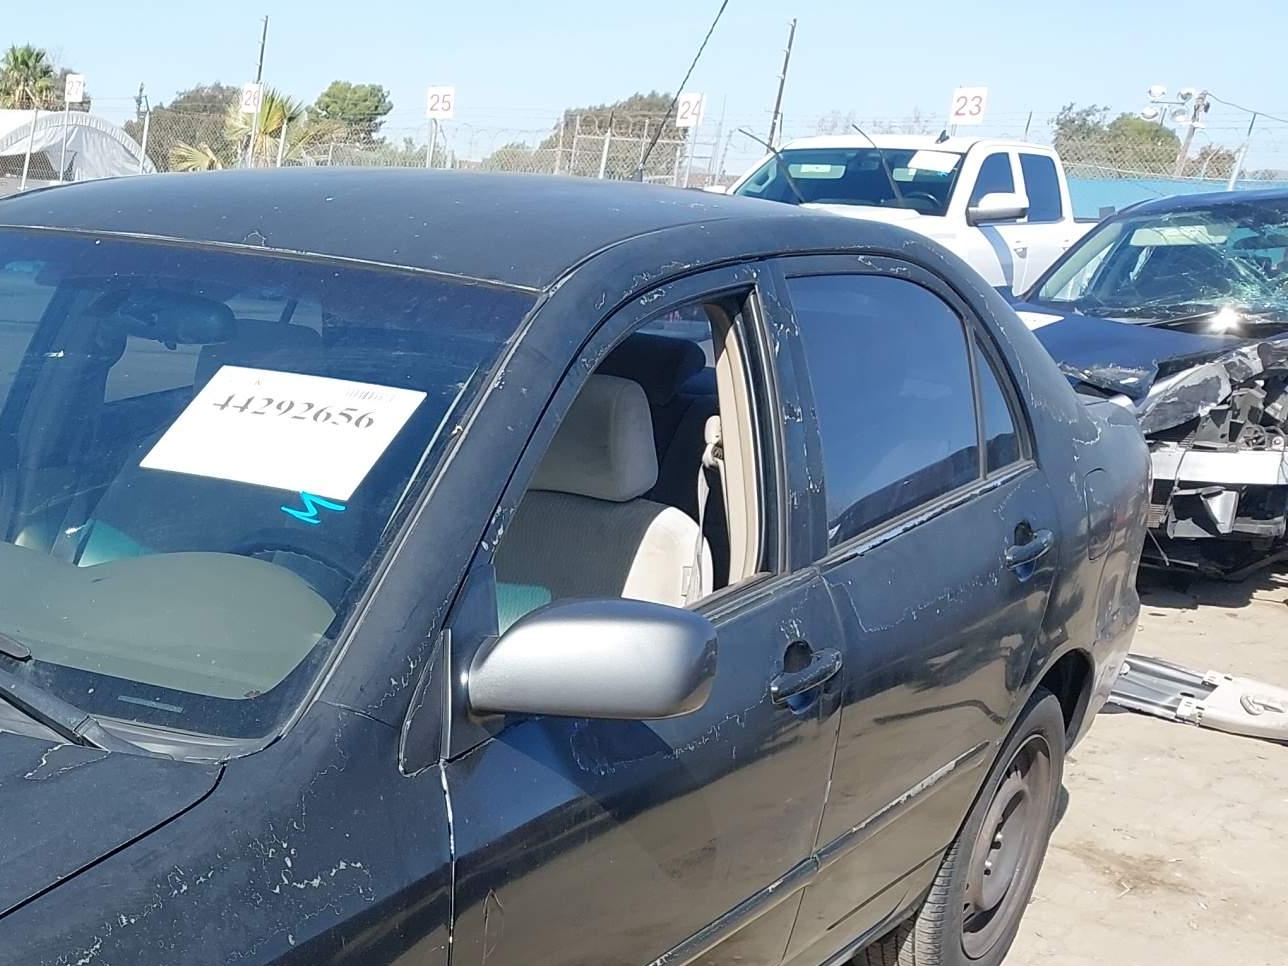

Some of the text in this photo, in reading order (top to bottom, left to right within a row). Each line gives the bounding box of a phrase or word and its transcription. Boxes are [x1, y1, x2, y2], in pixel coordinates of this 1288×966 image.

[429, 94, 451, 112] 25
[679, 100, 702, 120] 24
[954, 95, 983, 116] 23
[213, 393, 376, 429] 44292656
